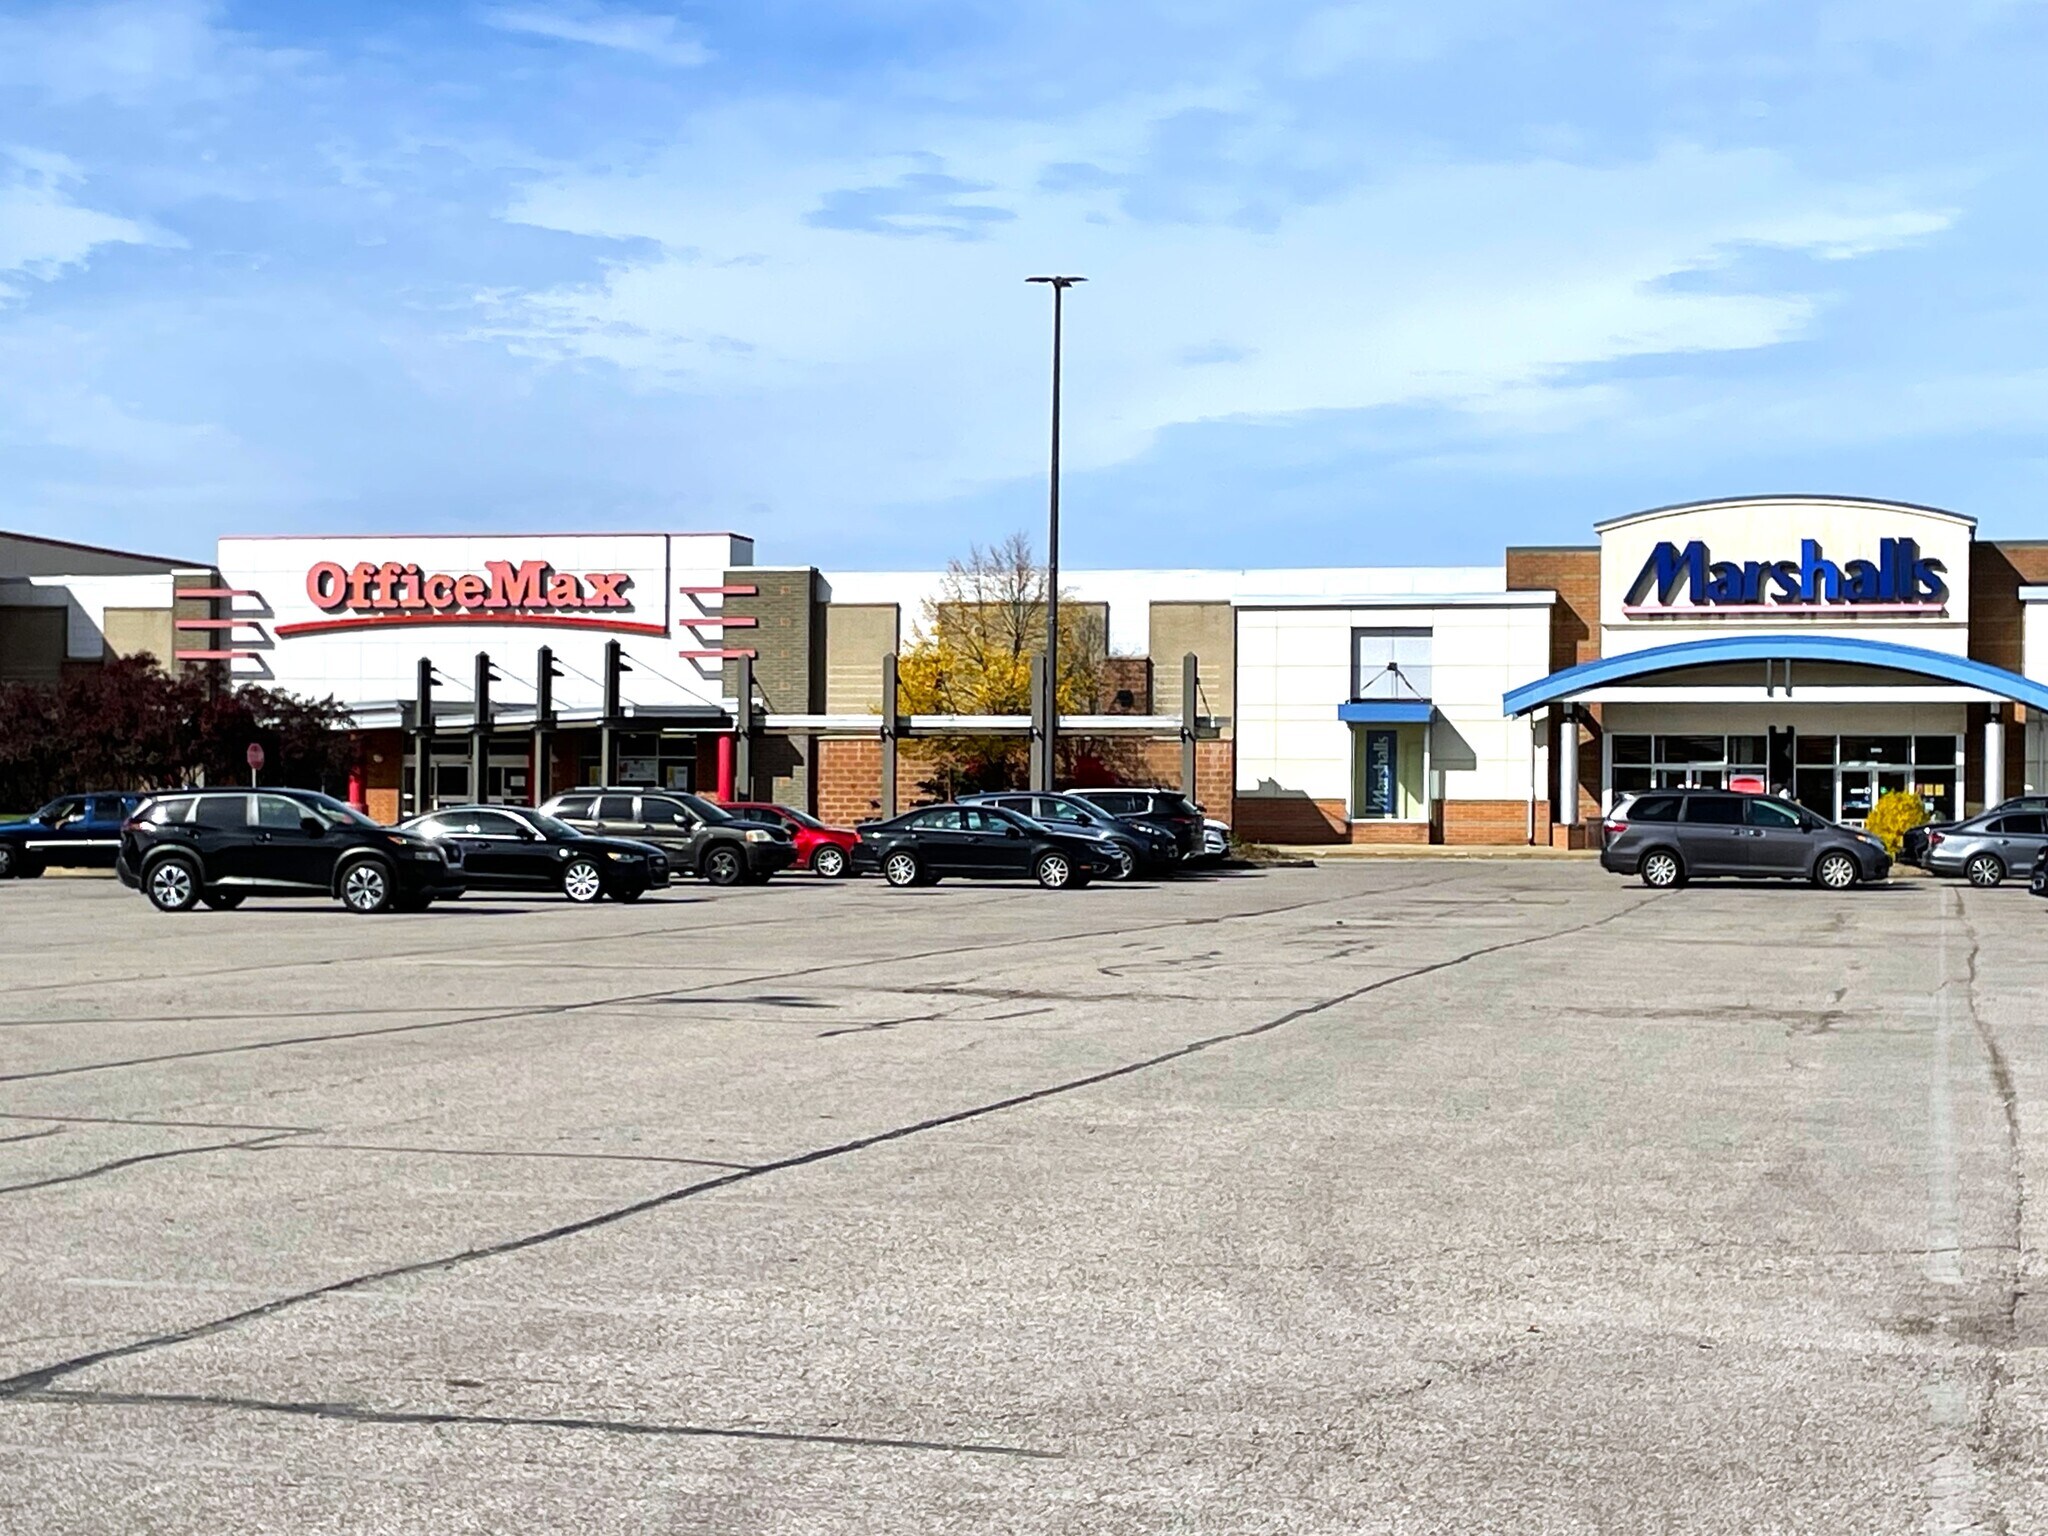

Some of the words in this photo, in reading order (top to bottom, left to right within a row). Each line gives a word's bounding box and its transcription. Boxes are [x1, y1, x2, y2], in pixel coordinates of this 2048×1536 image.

[305, 559, 630, 610] OfficeMax
[1623, 537, 1949, 606] Marshalls
[1371, 735, 1389, 810] Marshalls
